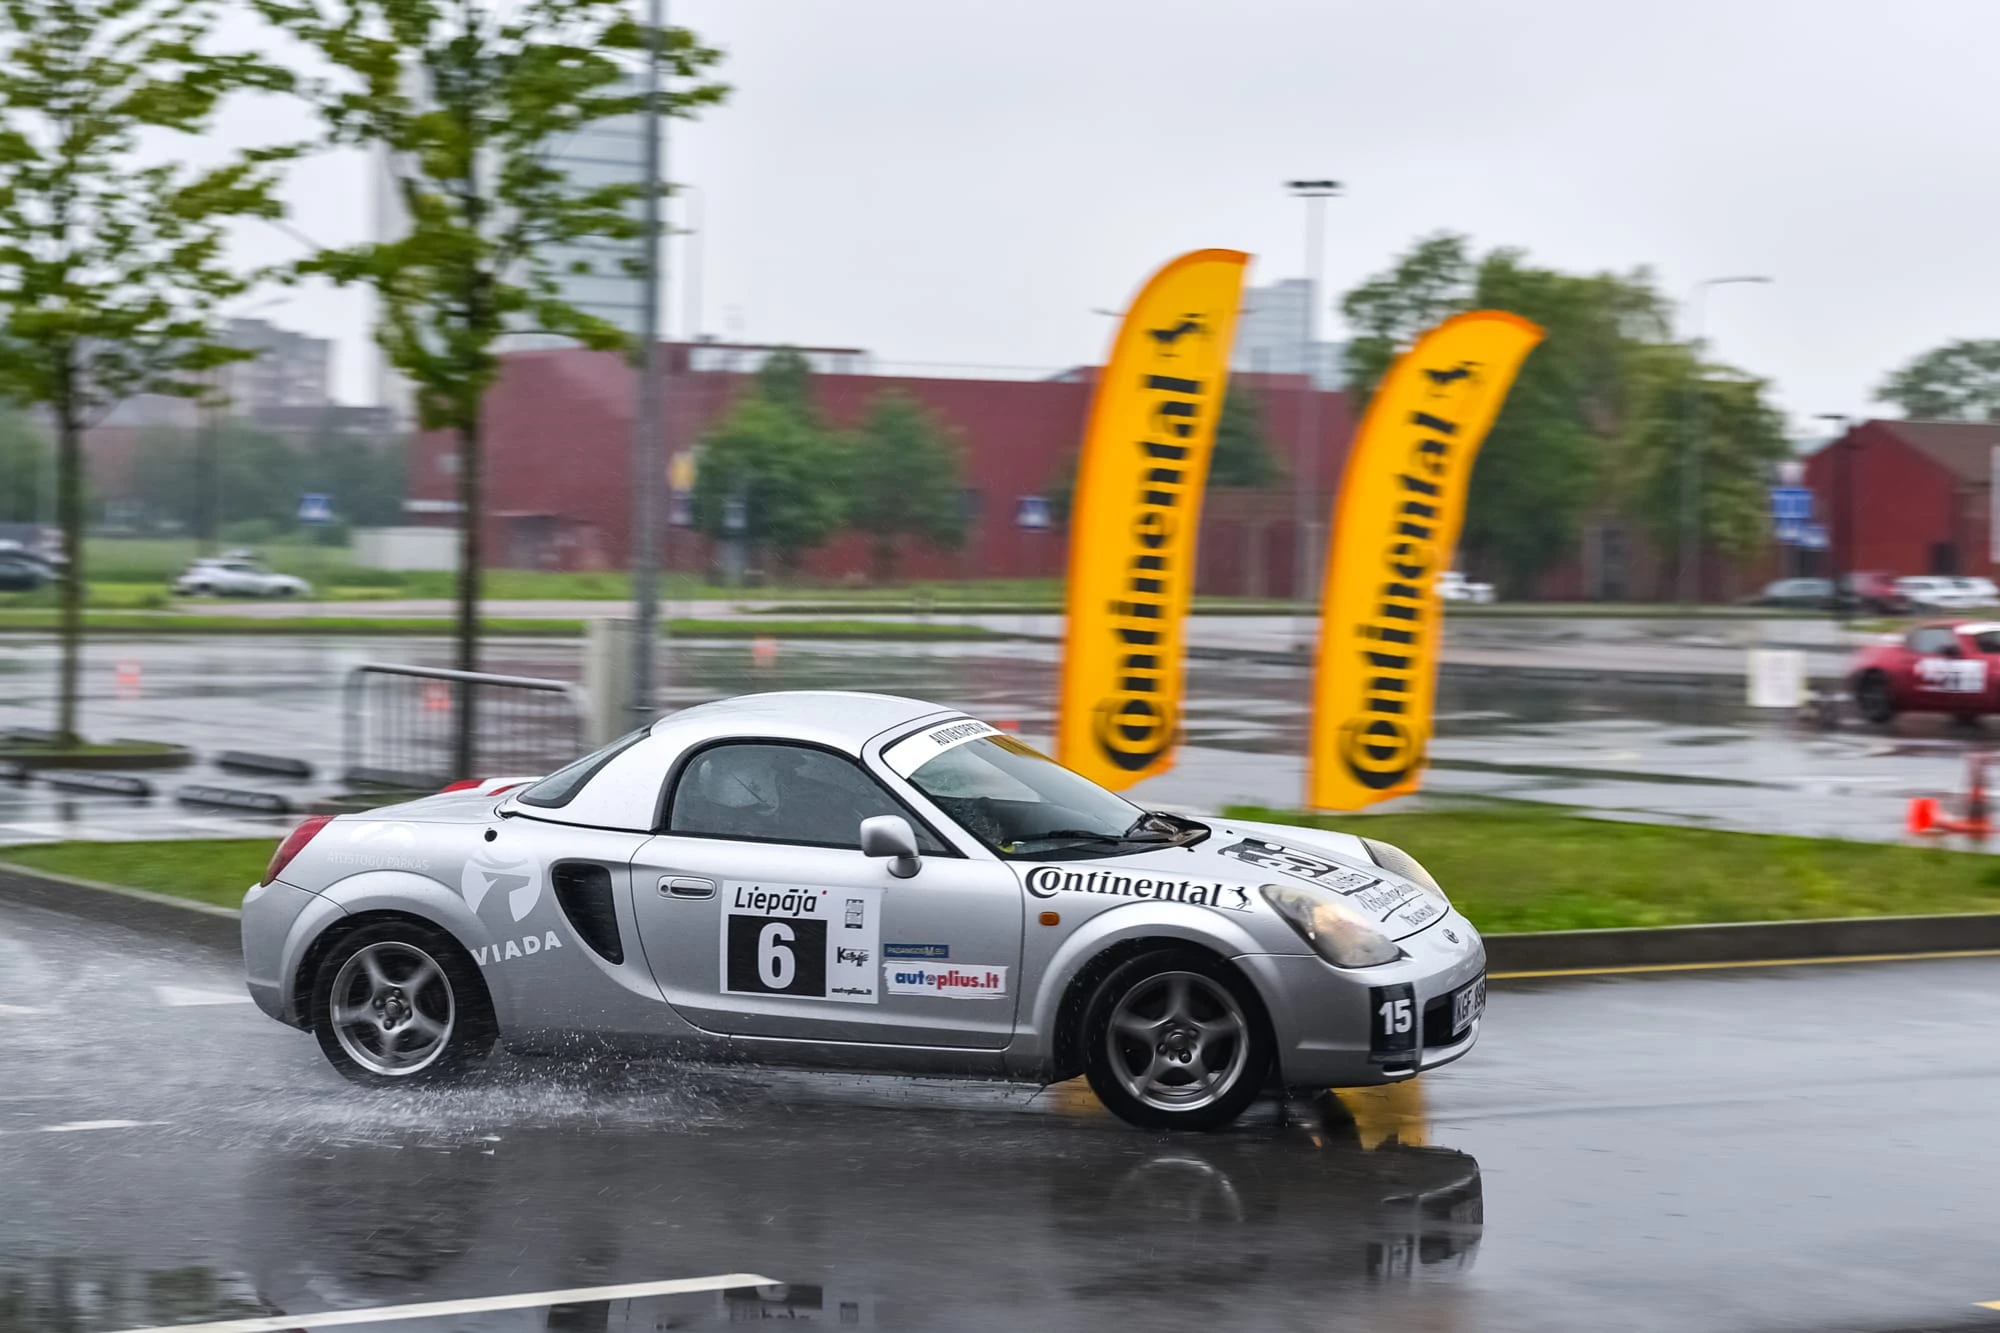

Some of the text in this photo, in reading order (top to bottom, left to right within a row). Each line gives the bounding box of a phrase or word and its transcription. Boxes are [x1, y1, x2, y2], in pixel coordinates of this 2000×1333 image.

[734, 886, 817, 917] Liepāja
[1025, 866, 1222, 908] Continental
[470, 930, 563, 966] VIADA
[758, 922, 796, 990] 6
[1379, 998, 1412, 1035] 15
